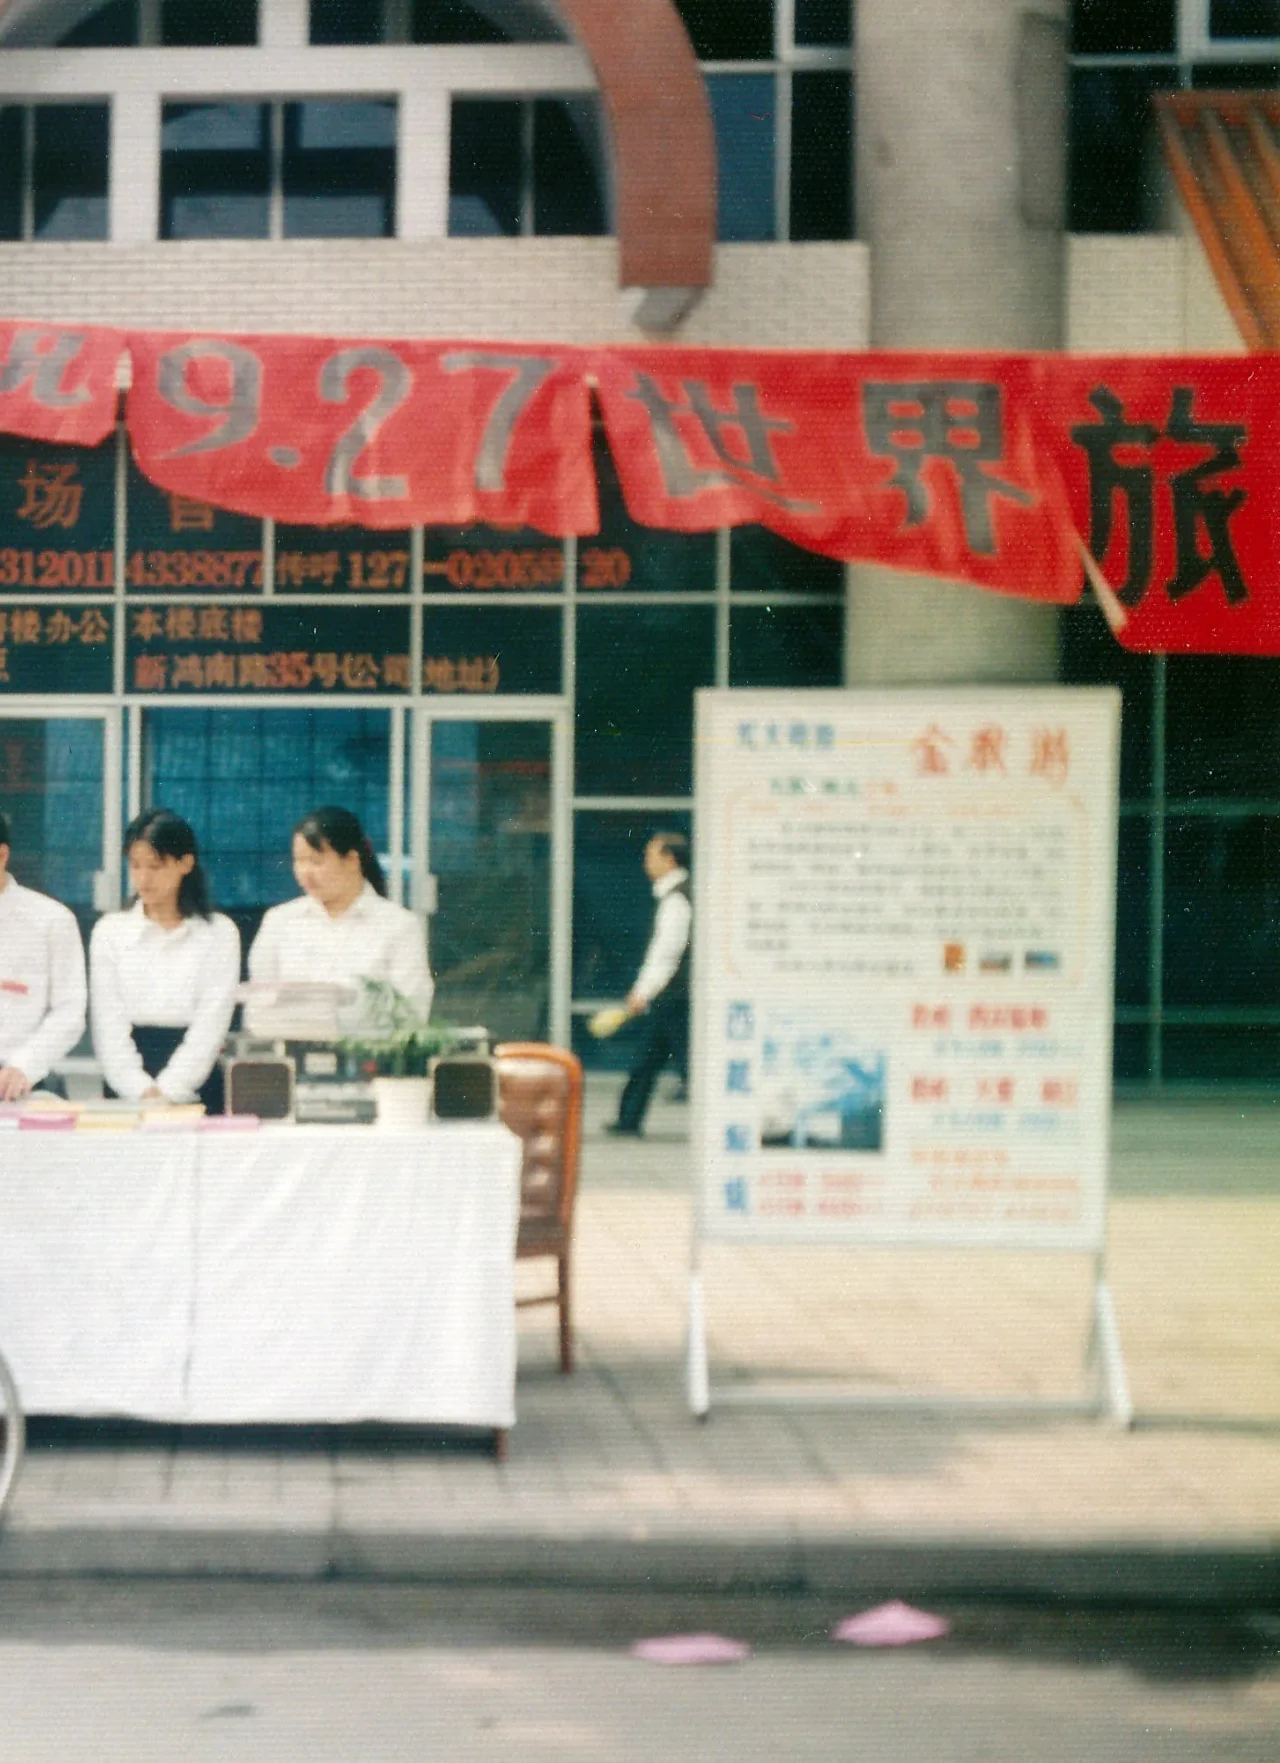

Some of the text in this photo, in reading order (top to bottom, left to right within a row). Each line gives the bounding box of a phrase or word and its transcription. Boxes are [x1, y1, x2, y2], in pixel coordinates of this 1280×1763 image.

[156, 338, 560, 498] 9.27
[625, 371, 1249, 608] 世界旅
